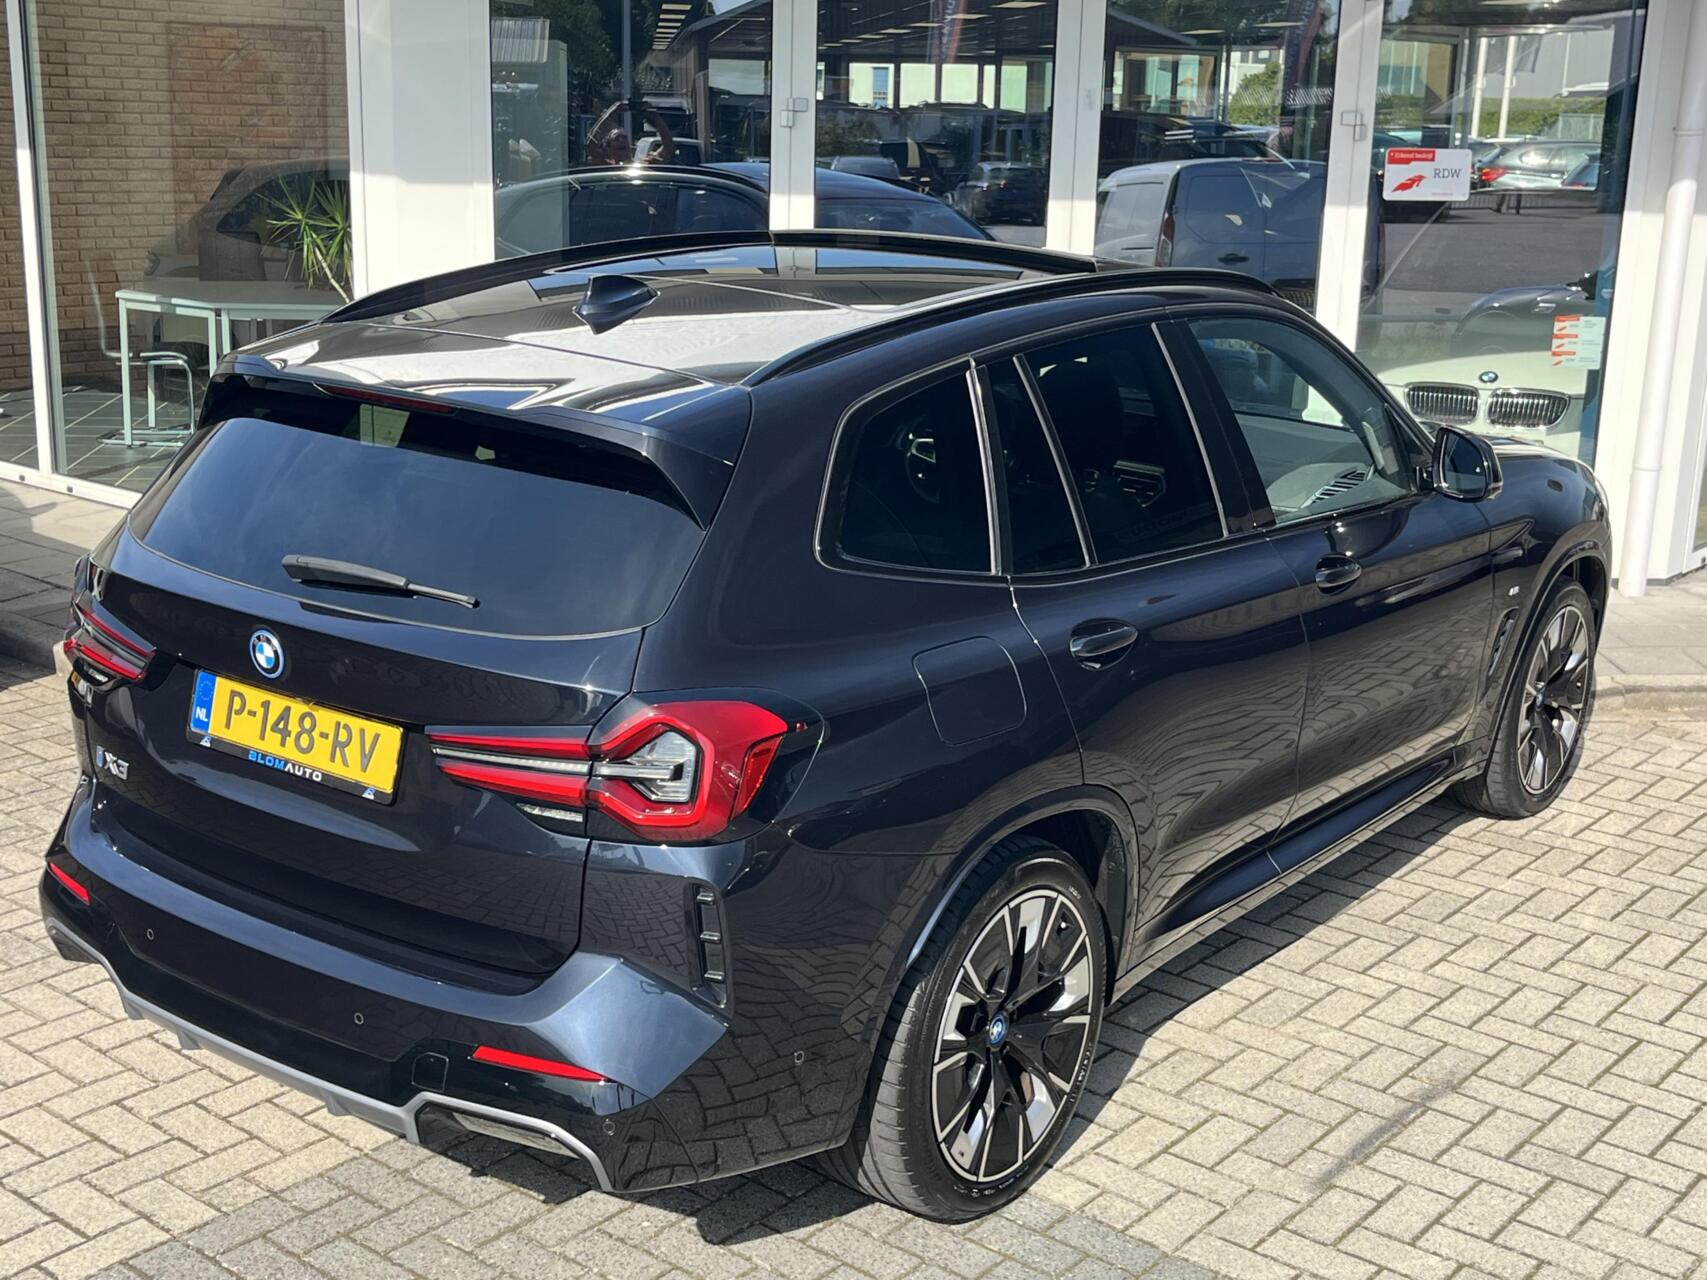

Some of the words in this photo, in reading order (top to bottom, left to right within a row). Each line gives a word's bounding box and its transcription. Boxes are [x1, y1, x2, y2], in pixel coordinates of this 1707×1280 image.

[1433, 168, 1461, 178] RDW
[195, 706, 208, 722] NL
[225, 689, 381, 773] P-148-RV
[248, 750, 322, 782] BLOMAUTO
